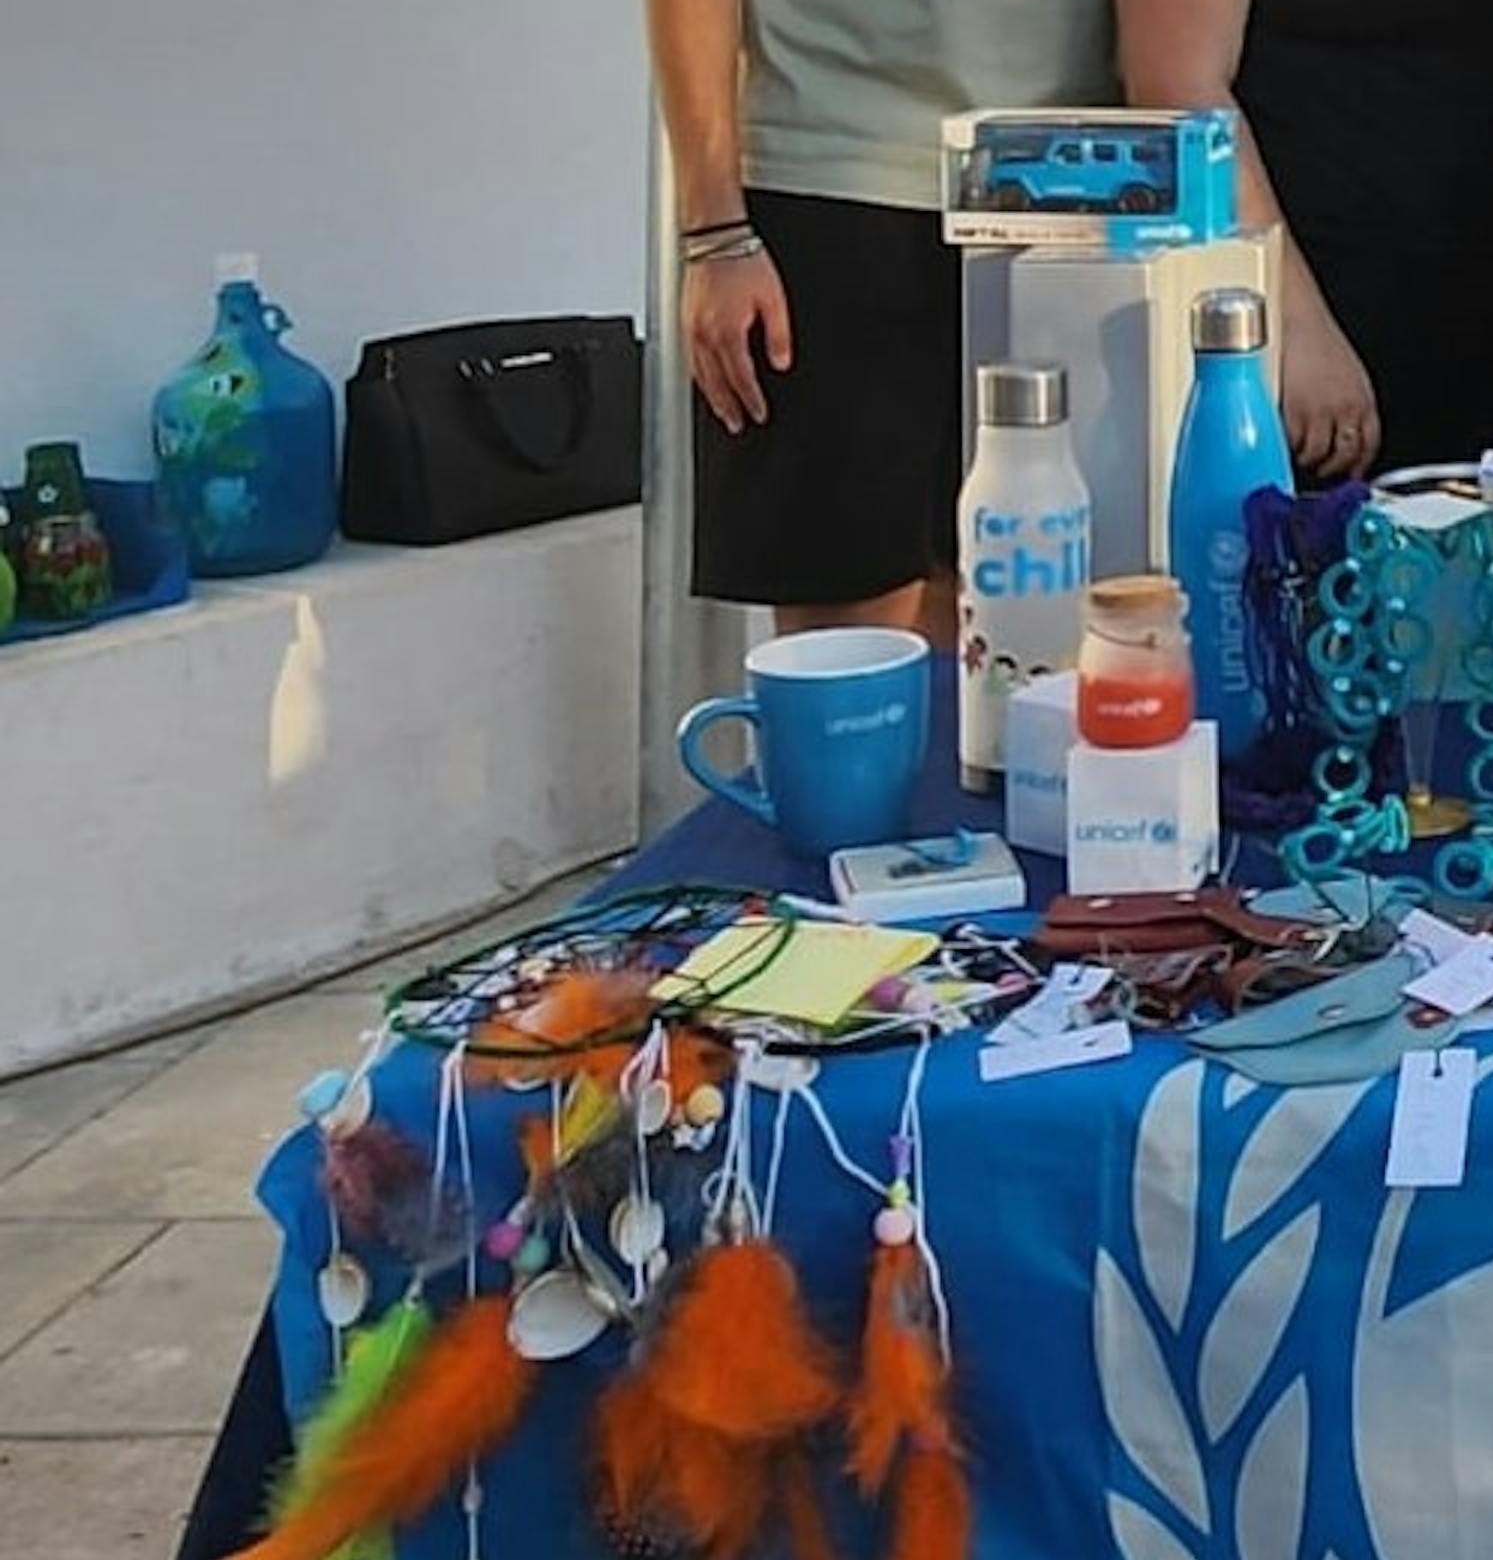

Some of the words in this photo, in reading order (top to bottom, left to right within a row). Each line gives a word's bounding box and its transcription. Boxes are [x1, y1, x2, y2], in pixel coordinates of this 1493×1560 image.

[974, 506, 1021, 544] for
[974, 538, 1086, 598] chil
[1208, 579, 1250, 692] unicef
[1075, 819, 1148, 842] unicef
